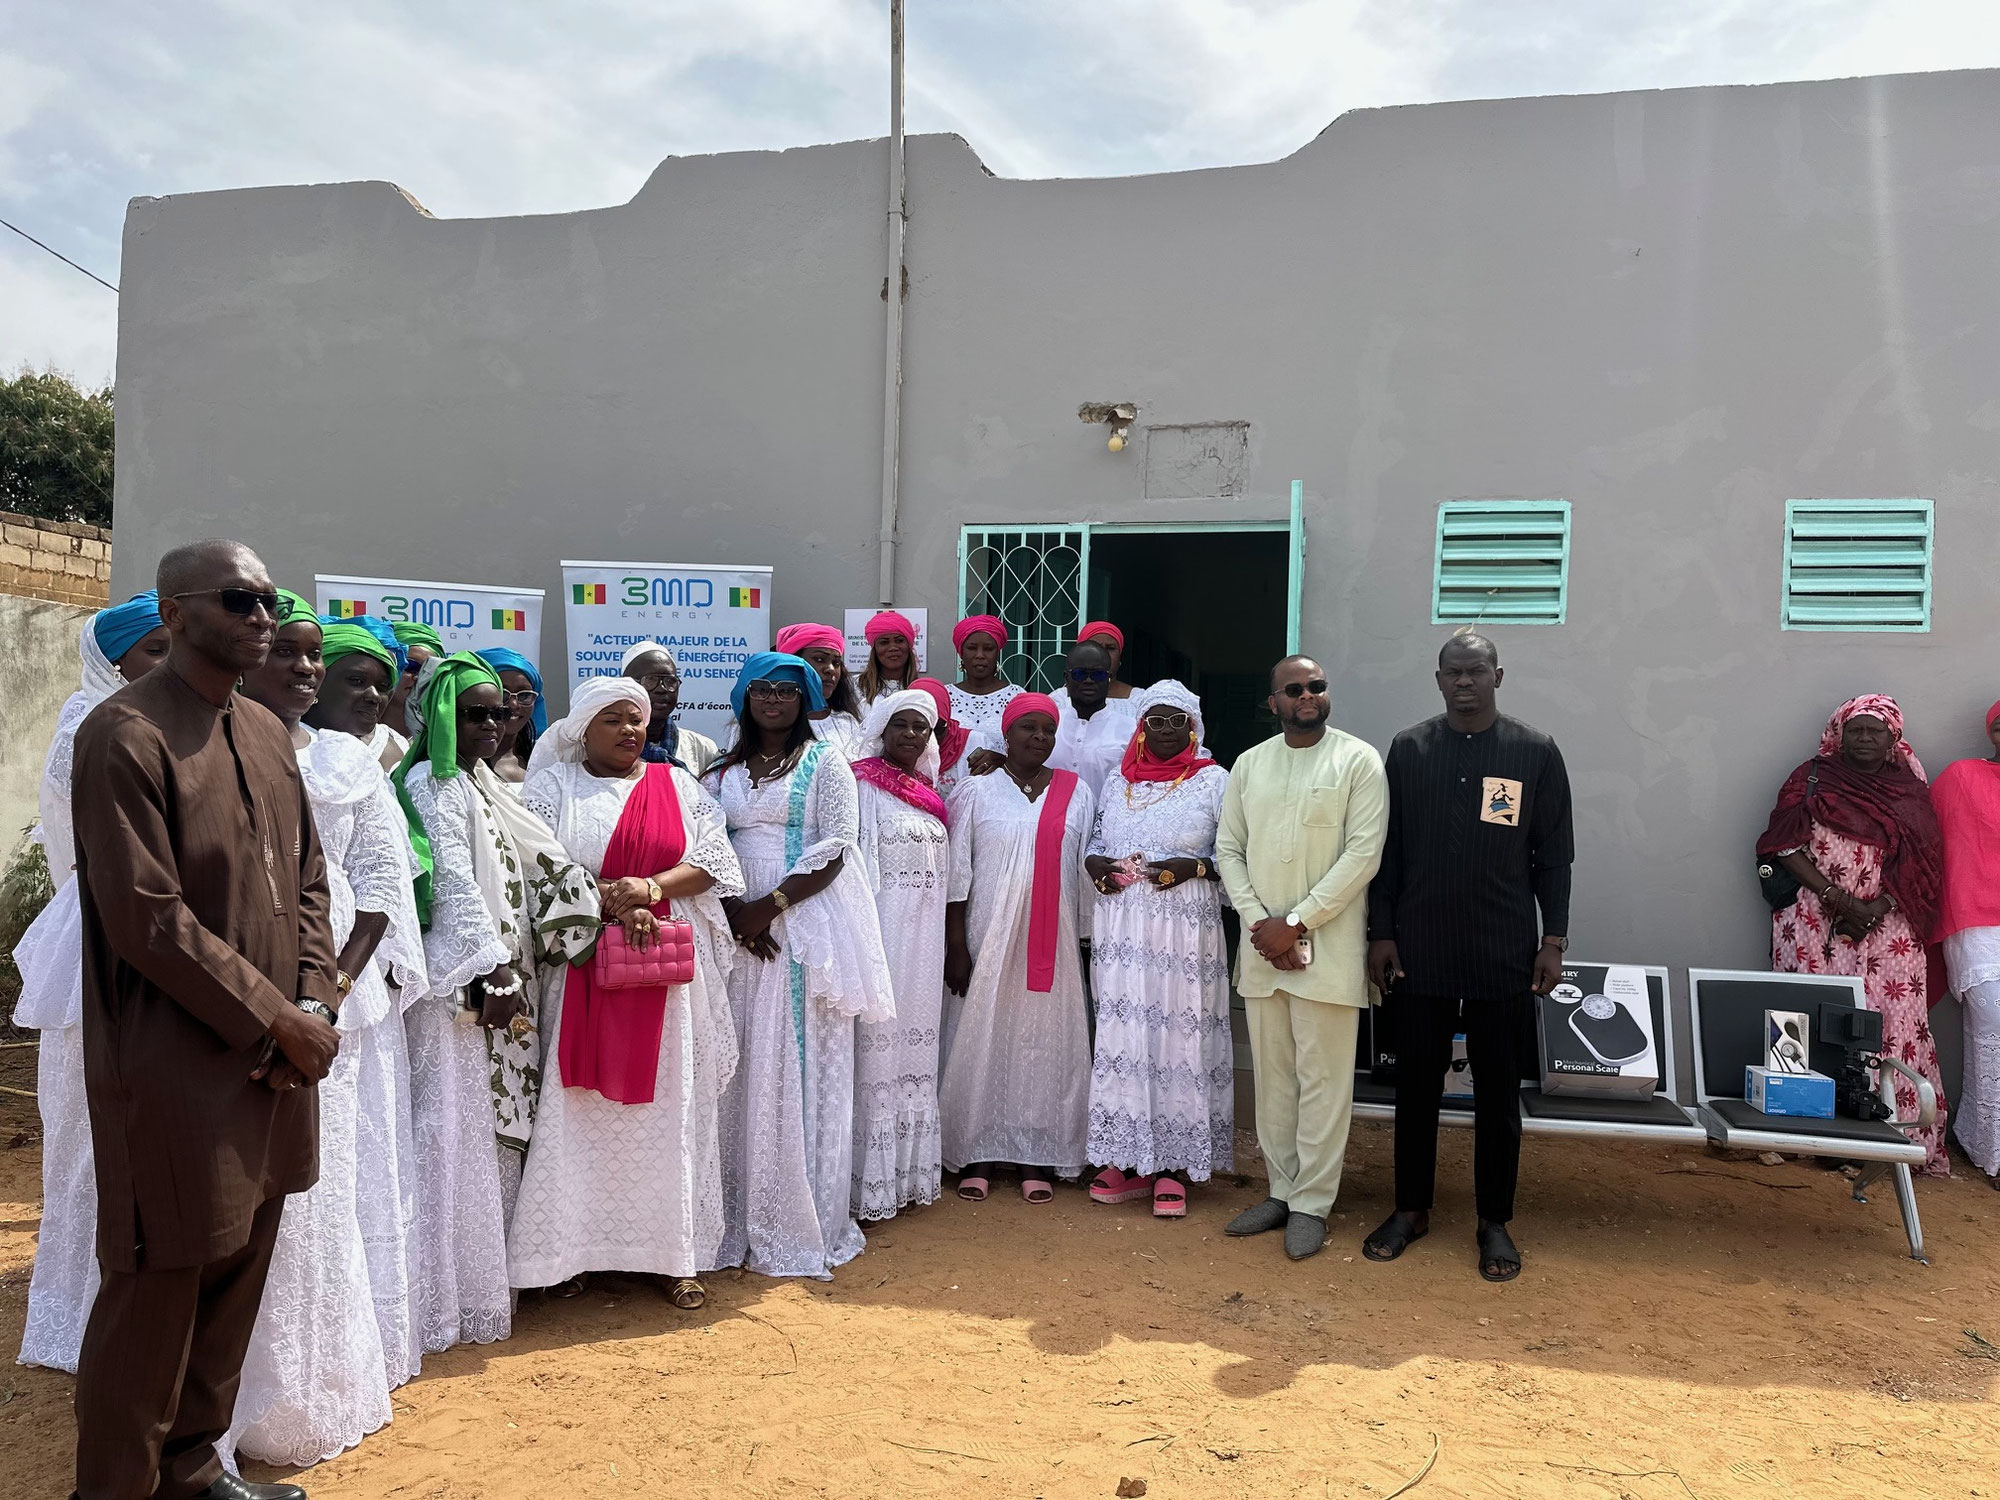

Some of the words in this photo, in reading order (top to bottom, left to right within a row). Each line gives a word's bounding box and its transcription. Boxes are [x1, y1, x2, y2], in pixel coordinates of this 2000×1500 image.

[621, 611, 712, 619] ENERGY
[656, 635, 709, 646] MAJEUR
[714, 637, 730, 647] DE
[732, 637, 748, 647] LA
[578, 668, 592, 678] ET
[683, 668, 702, 678] AU
[676, 702, 695, 710] CFA
[1380, 1053, 1396, 1064] Per
[1554, 1060, 1594, 1071] Personal
[1595, 1064, 1619, 1074] Scale
